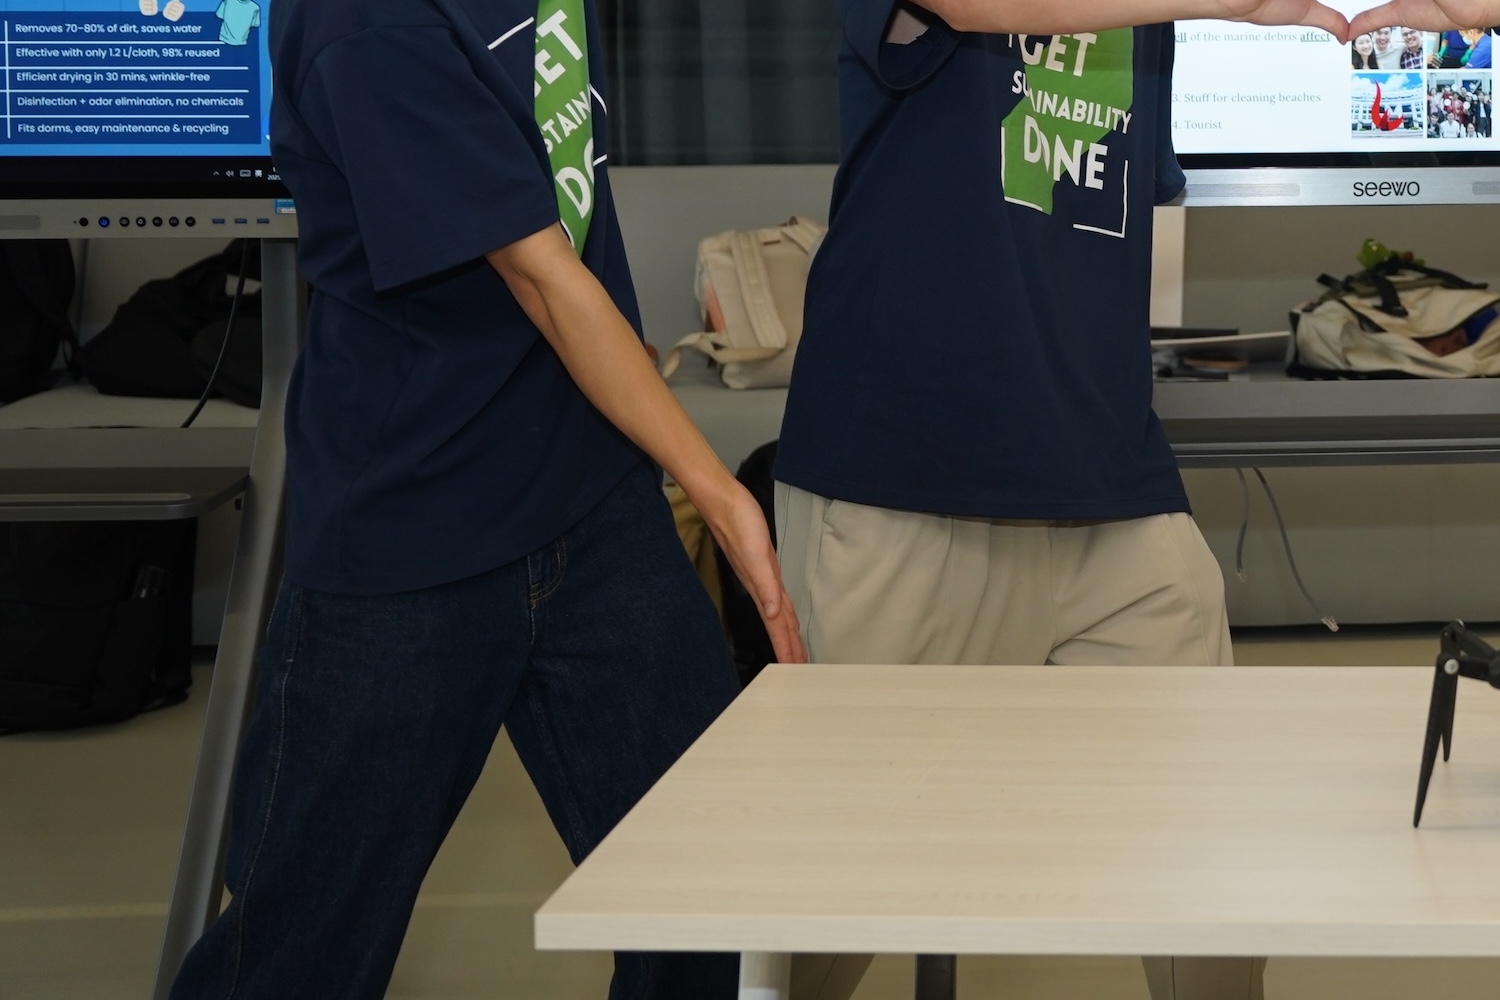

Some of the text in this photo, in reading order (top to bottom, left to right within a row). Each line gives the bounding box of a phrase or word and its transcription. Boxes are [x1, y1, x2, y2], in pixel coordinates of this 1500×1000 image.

[15, 24, 63, 33] Removes
[106, 23, 118, 33] of
[119, 23, 139, 34] dirt,
[172, 24, 202, 33] water
[16, 46, 220, 59] Effective with only 1.2 L/cloth, 98% reused
[534, 9, 584, 98] ET
[16, 72, 210, 84] Efficient drying in 30 mins, wrinkle-free
[17, 96, 77, 106] Disinfection
[88, 97, 113, 106] odor
[114, 96, 174, 107] elimination,
[175, 98, 190, 106] no
[191, 96, 244, 106] chemicals
[1184, 93, 1210, 102] Stuff
[1212, 93, 1228, 102] for
[1231, 93, 1276, 105] cleaning
[1278, 92, 1321, 102] beaches
[18, 123, 229, 135] Fits dorms, easy maintenance & recycling
[1184, 120, 1222, 129] Tourist
[1353, 181, 1420, 197] seewo
